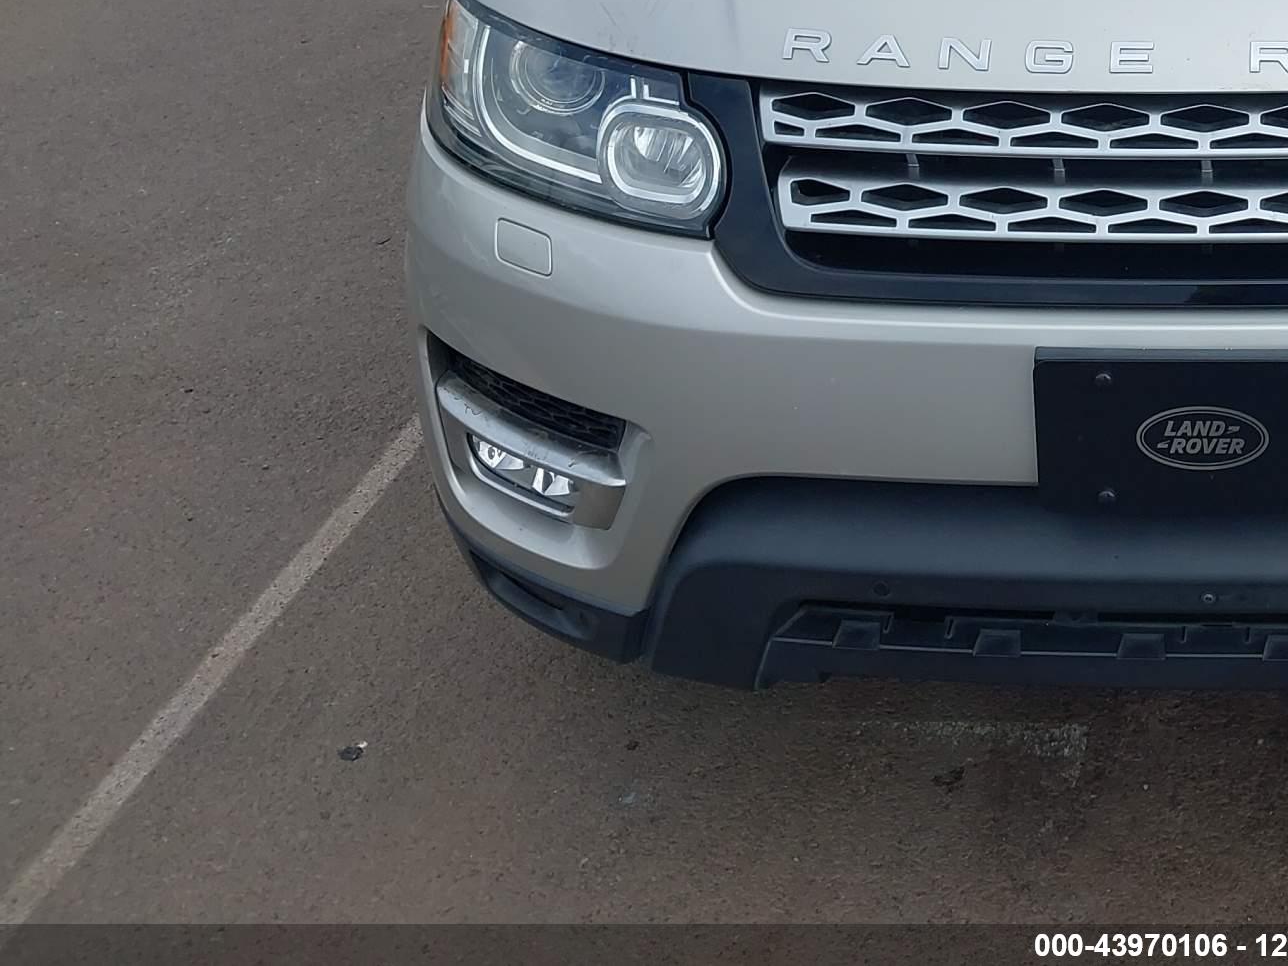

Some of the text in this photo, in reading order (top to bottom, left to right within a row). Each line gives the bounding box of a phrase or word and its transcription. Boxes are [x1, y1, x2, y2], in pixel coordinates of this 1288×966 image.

[781, 27, 1155, 75] RANGE
[1163, 420, 1225, 437] LAND
[1169, 438, 1246, 455] ROVER
